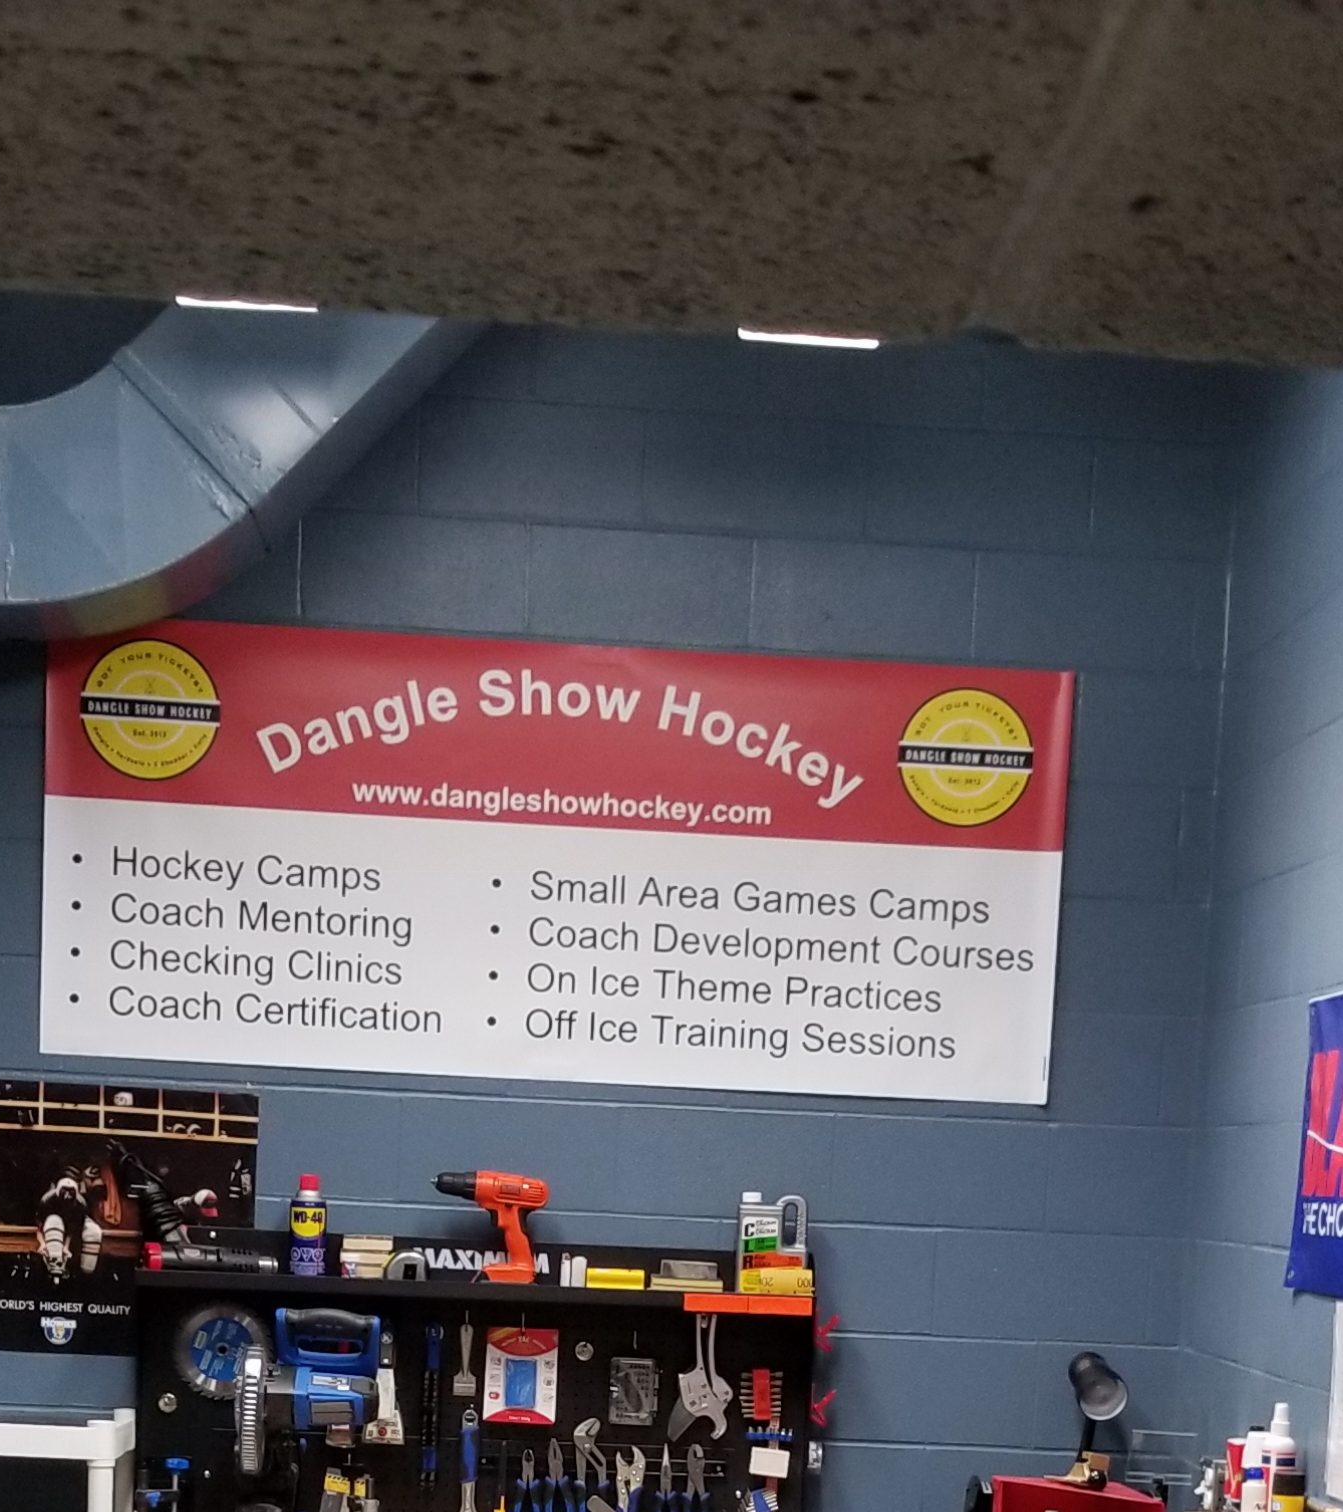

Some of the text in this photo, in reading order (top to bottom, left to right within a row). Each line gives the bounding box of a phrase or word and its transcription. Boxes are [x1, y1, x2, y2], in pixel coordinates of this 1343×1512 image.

[88, 701, 212, 720] DANGLE SHOW HOCKEY
[256, 679, 458, 775] Dangle
[477, 668, 641, 723] Show
[657, 684, 865, 809] Hockey
[905, 750, 1026, 766] DANGLE SHOW HOCKEY
[352, 782, 772, 826] www.dangleshowhockey.com
[111, 845, 381, 896] Hockey Camps
[111, 892, 413, 947] Coach Mentoring
[530, 869, 990, 925] Small Area Games Camps
[110, 939, 403, 986] Checking Clinics
[529, 916, 1034, 973] Coach Development Courses
[109, 986, 443, 1034] Coach Certification
[527, 963, 942, 1014] On Ice Theme Practices
[525, 1008, 957, 1060] Off Ice Training Sessions
[293, 1211, 323, 1224] WD-40
[414, 1247, 549, 1274] MAXIMM
[40, 1301, 83, 1312] HIGHEST
[88, 1304, 130, 1315] QUALITY
